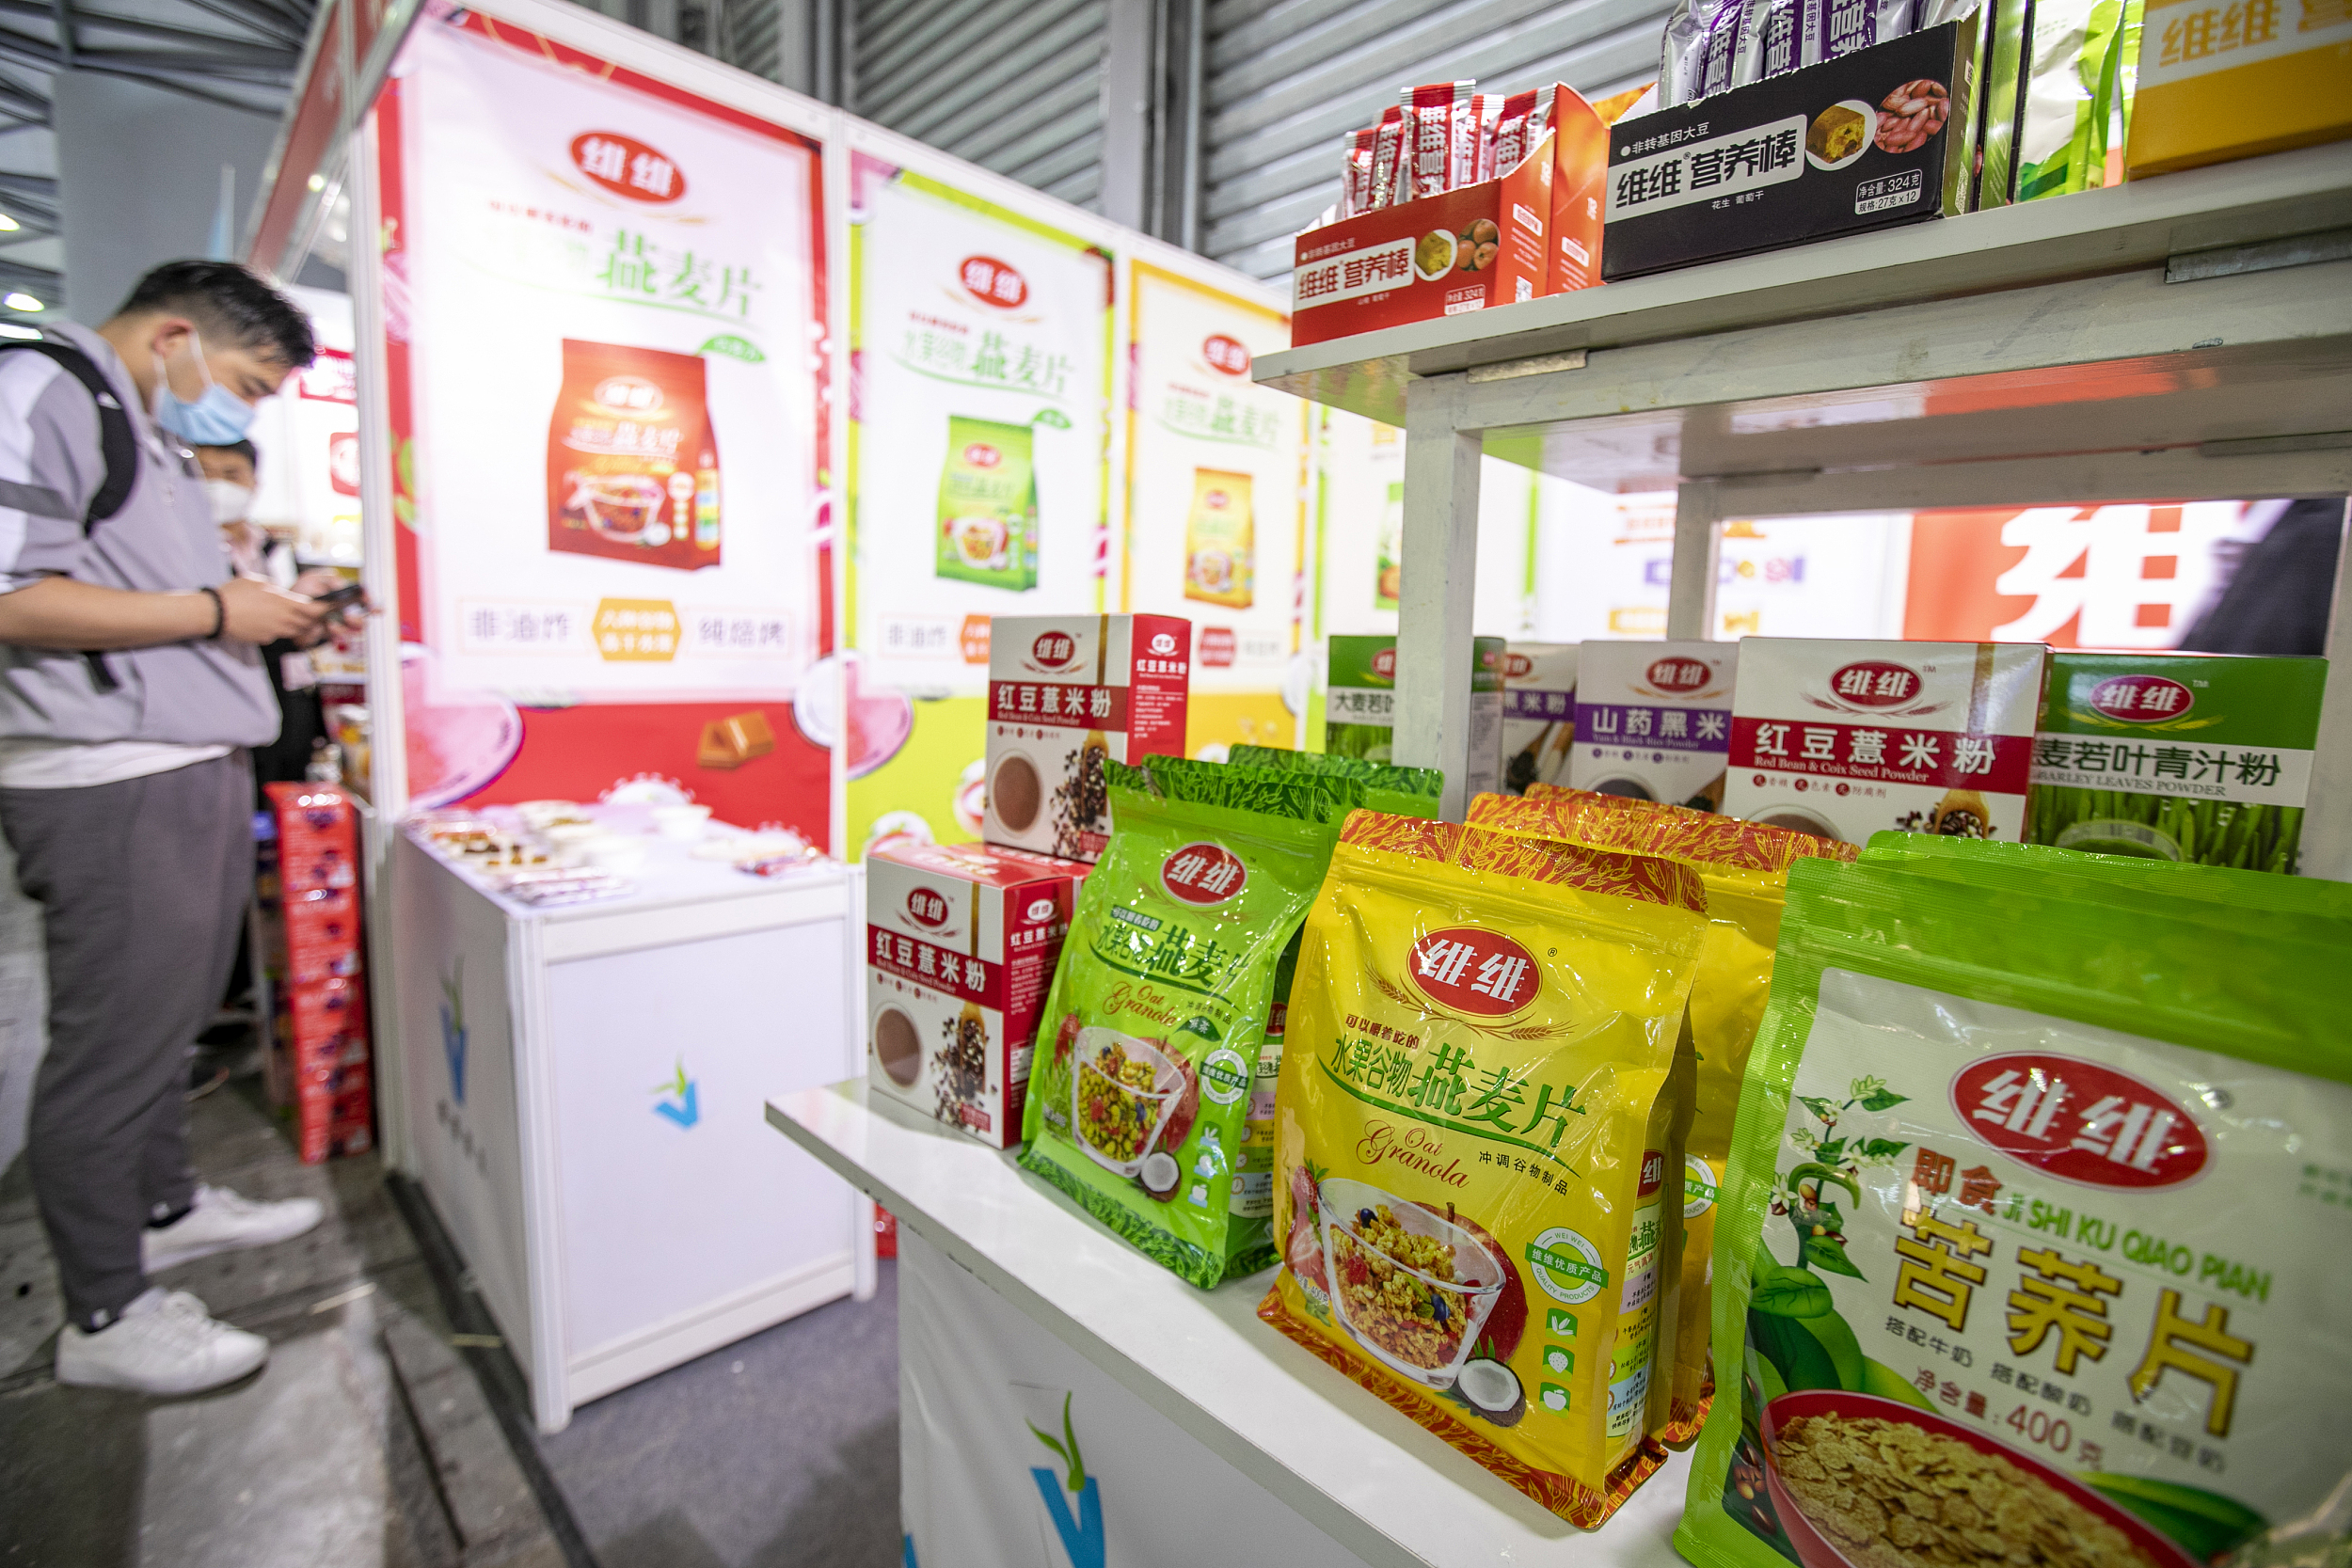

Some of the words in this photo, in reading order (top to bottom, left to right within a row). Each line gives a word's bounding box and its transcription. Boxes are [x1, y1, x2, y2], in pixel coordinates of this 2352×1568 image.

[2159, 0, 2281, 68] 维维
[1632, 122, 1709, 154] 非转基因大豆
[580, 137, 674, 198] 维维
[1615, 159, 1681, 208] 维维
[1691, 128, 1797, 191] 营养棒
[1858, 170, 1920, 199] 净含量:324克
[1711, 198, 1731, 211] 花生
[1736, 190, 1765, 206] 葡萄干
[965, 261, 1024, 302] 维维
[1298, 264, 1339, 300] 维维
[1343, 247, 1409, 289] 营养棒
[1205, 340, 1249, 372] 维维
[1036, 638, 1071, 660] 维维
[1653, 662, 1702, 689] 维维
[1838, 667, 1913, 699] 维维
[997, 684, 1112, 719] 红豆薏米粉
[2099, 684, 2183, 712] 维维
[1592, 706, 1726, 741] 山药黑米
[1755, 722, 1995, 775] 红豆薏米粉
[1754, 755, 1776, 768] Red
[1778, 757, 1807, 770] Bean
[1807, 760, 1819, 771] &
[1820, 761, 1848, 774] Coix
[1850, 763, 1879, 778] Seed
[1882, 767, 1930, 783] Powder
[2039, 770, 2094, 784] BARLEY
[2096, 773, 2153, 789] LEAVES
[2156, 779, 2227, 798] POWDER
[1167, 852, 1242, 896] 维维
[911, 893, 943, 921] 维维
[875, 929, 986, 993] 红豆薏米粉
[1418, 938, 1530, 1004] 维维
[1103, 981, 1176, 1027] Granola
[1137, 986, 1165, 1006] Oat
[1345, 1014, 1420, 1051] 可以嚼着吃的
[1329, 1032, 1587, 1149] 水果谷物燕麦片
[1973, 1069, 2185, 1174] 维维
[1356, 1119, 1470, 1190] Granola
[1404, 1128, 1442, 1155] Oat
[1479, 1150, 1568, 1197] 冲调谷物制品
[1910, 1147, 2004, 1215] 即食
[1570, 1235, 1584, 1248] WEI
[2026, 1198, 2072, 1239] SHI
[2075, 1210, 2117, 1252] KU
[2122, 1228, 2195, 1276] QIAO
[2198, 1252, 2273, 1304] PIAN
[1532, 1248, 1602, 1283] 维维优质产品
[1536, 1267, 1557, 1293] QUALITY
[1560, 1285, 1595, 1300] PRODUCTS
[1893, 1204, 2255, 1439] 苦荞片
[1884, 1314, 1974, 1369] 搭配牛奶
[1990, 1361, 2092, 1418] 搭配酸奶
